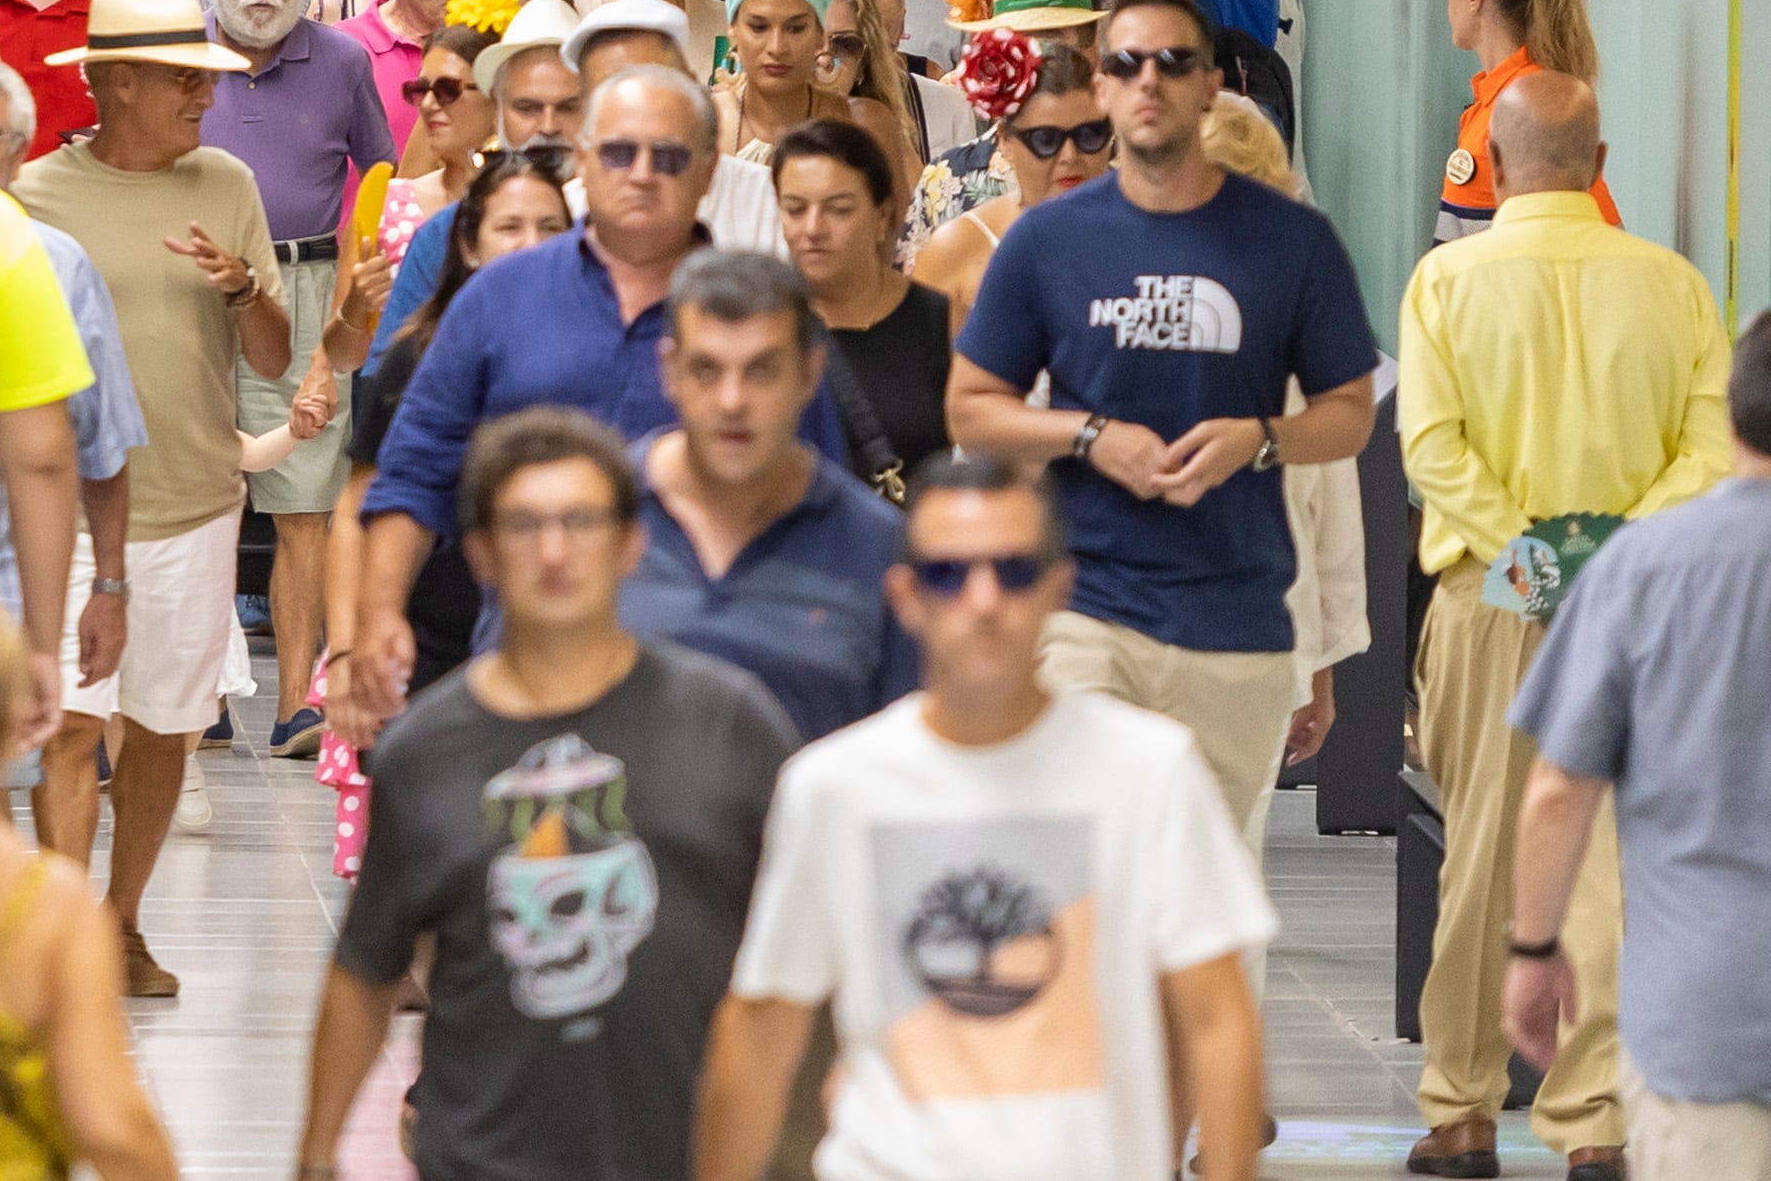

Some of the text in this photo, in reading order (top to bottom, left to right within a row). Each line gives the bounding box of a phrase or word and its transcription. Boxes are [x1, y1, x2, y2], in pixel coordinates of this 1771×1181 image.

[1136, 276, 1192, 298] THE
[1091, 299, 1189, 325] NORTH
[1115, 323, 1189, 349] FACE
